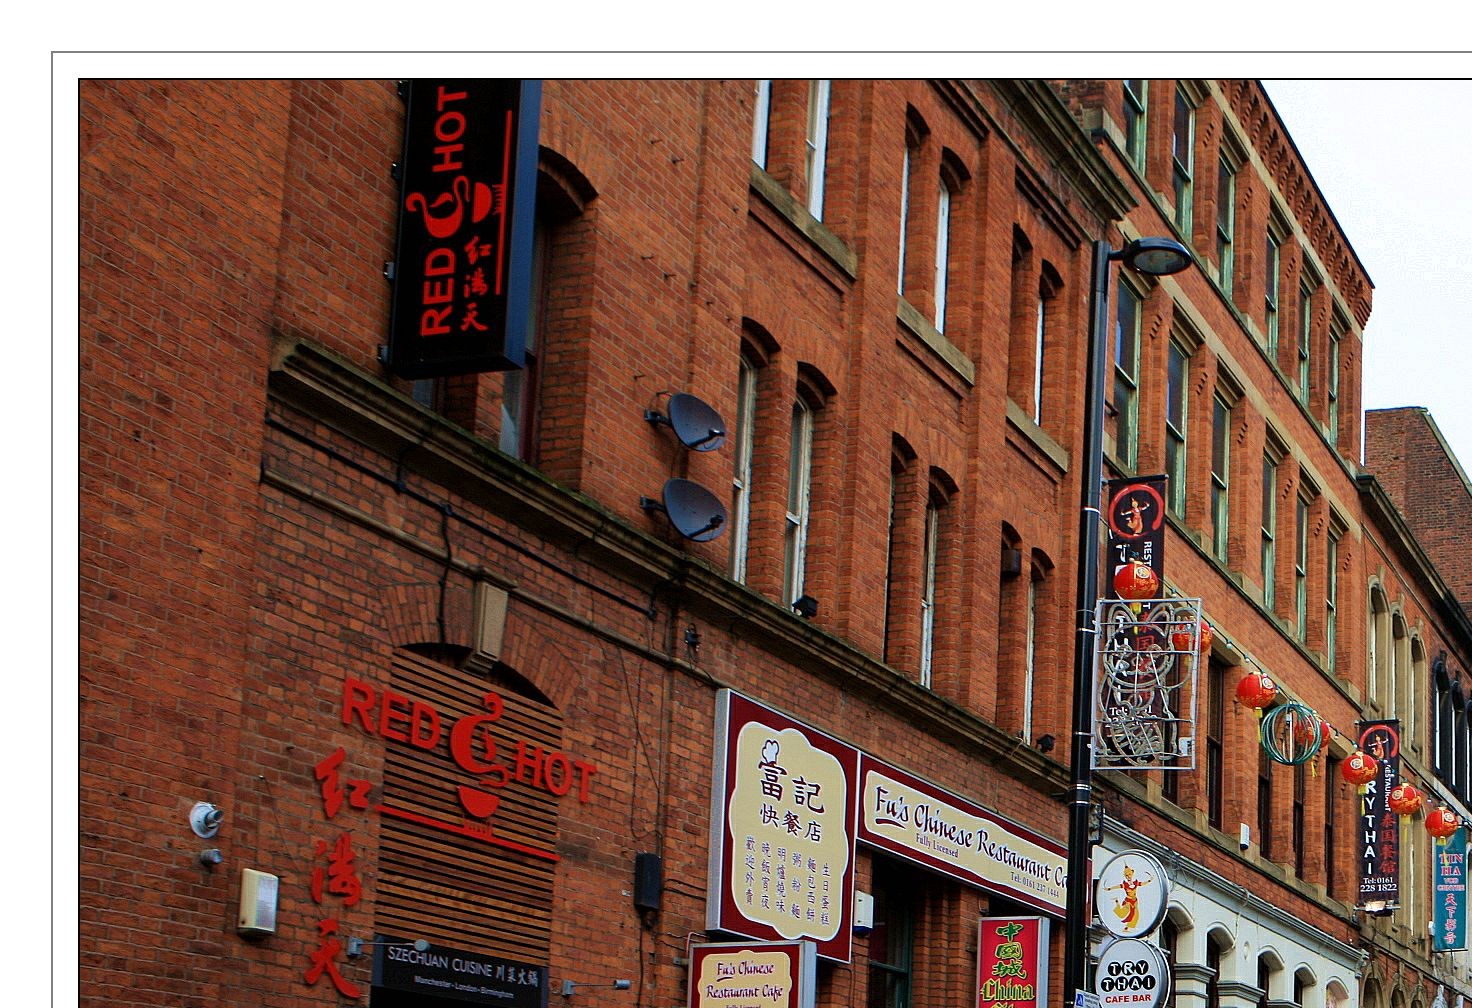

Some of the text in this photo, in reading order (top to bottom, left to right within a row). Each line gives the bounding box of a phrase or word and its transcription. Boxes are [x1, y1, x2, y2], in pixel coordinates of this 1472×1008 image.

[420, 86, 468, 336] RED HOT
[342, 677, 597, 804] RED HOT
[758, 761, 825, 814] 富記
[760, 803, 822, 842] 快餐店
[875, 786, 1068, 890] Fu's Chinese Restaurant Ca
[916, 833, 959, 859] Fully Licensed
[1011, 872, 1022, 884] Tel:
[1023, 876, 1035, 889] 0161
[1036, 881, 1046, 892] 237
[1441, 866, 1461, 876] HA
[1377, 883, 1398, 892] 1822
[388, 946, 448, 969] SZECHUAN
[452, 958, 492, 977] CUISINE
[992, 921, 1027, 979] 中國城
[717, 961, 774, 976] Fu's Chinese
[1108, 961, 1149, 976] TRY
[706, 984, 784, 1002] Restaurant Cafe
[980, 978, 1035, 1001] China
[1102, 975, 1156, 992] THAI
[1105, 994, 1152, 1004] CAFE BAR
